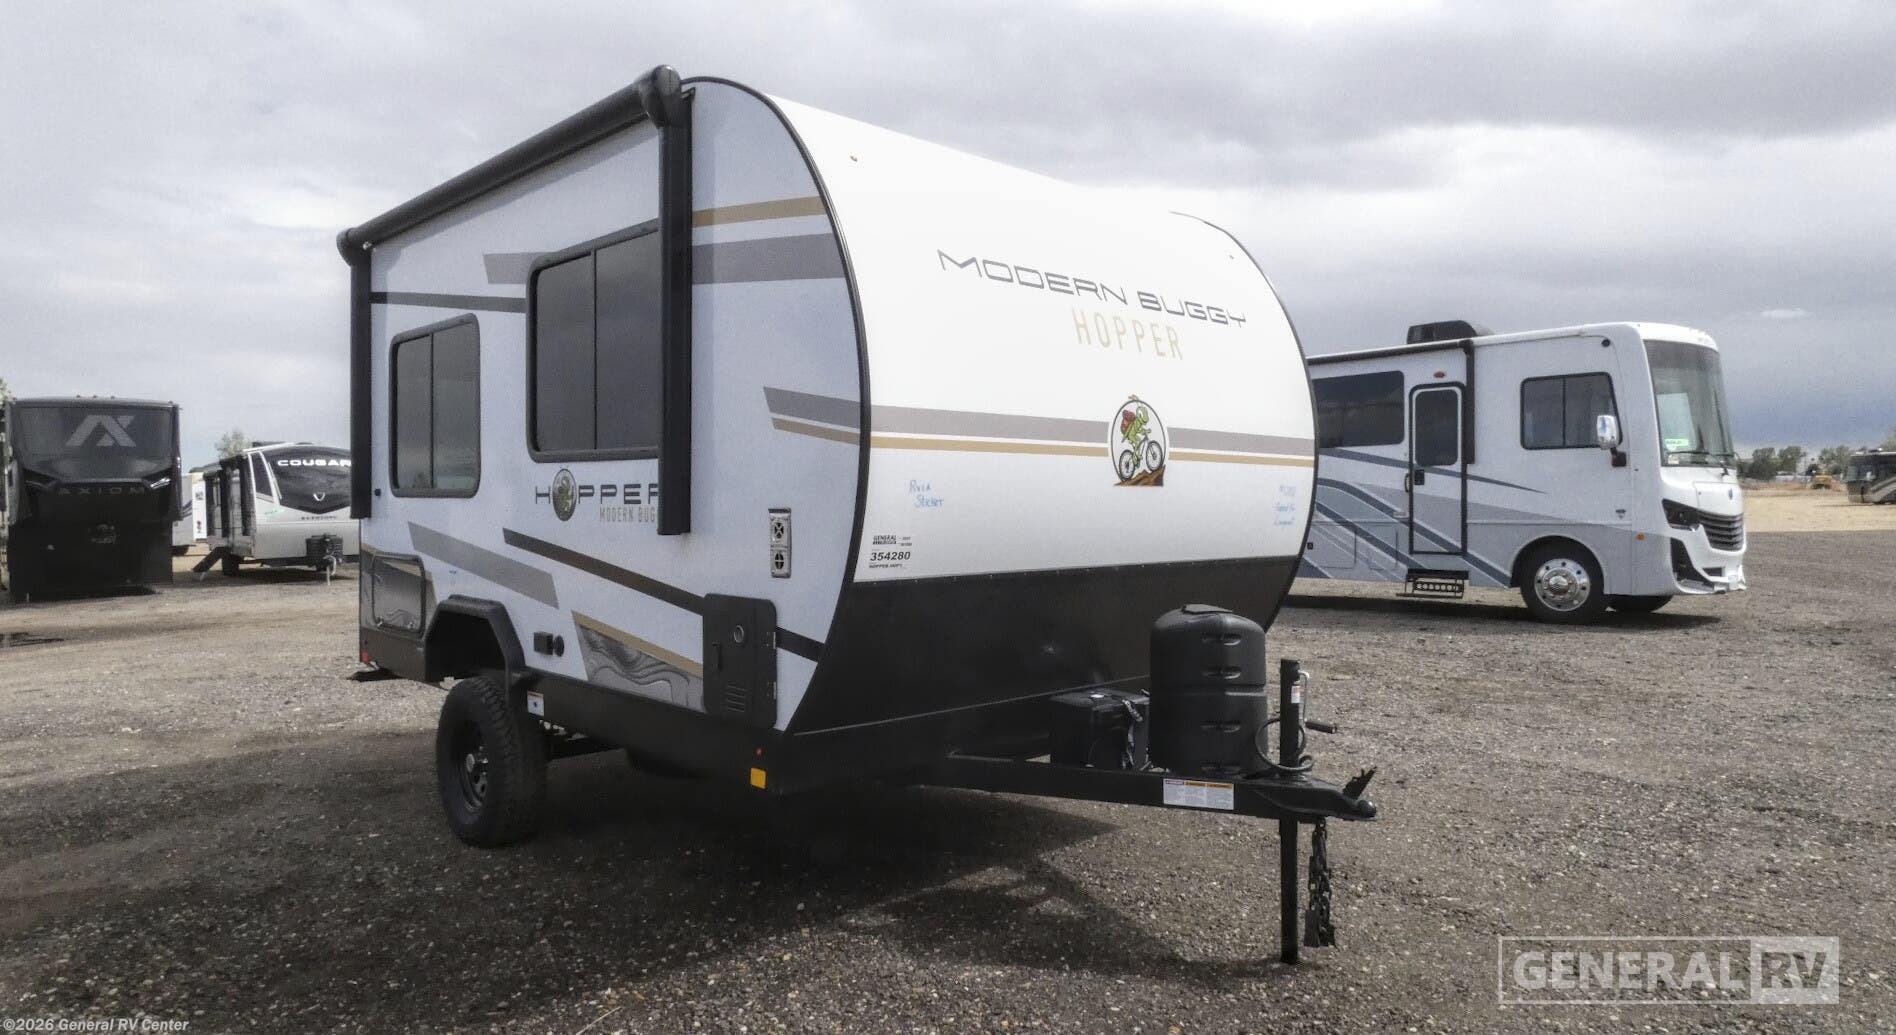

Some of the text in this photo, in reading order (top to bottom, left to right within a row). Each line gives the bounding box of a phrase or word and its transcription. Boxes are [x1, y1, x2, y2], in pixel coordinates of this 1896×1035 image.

[937, 249, 1247, 327] MODERN BUGGY
[1072, 307, 1184, 361] HOPPER
[277, 458, 352, 467] COUGAR
[59, 487, 145, 495] AXIOM
[600, 506, 634, 522] MODERN
[870, 552, 911, 561] 354280
